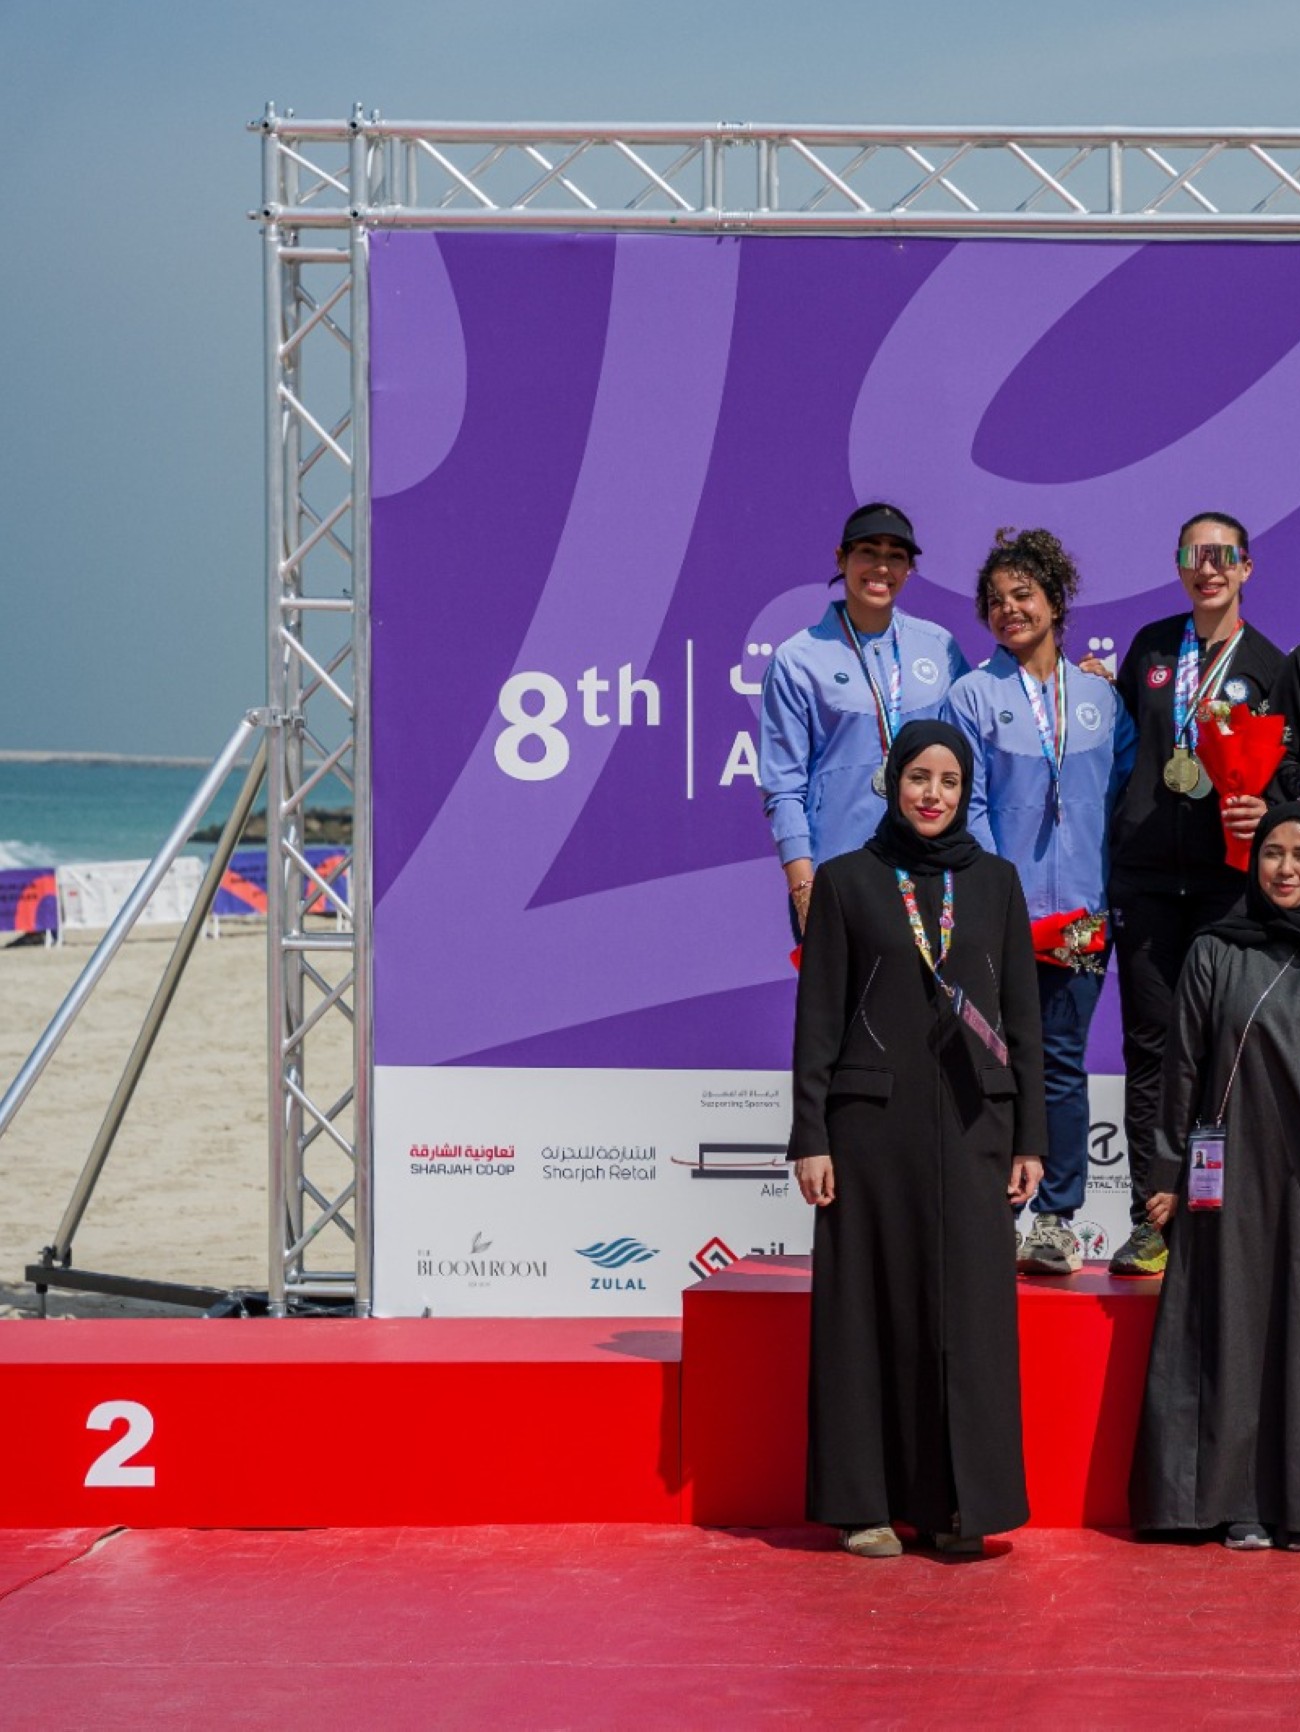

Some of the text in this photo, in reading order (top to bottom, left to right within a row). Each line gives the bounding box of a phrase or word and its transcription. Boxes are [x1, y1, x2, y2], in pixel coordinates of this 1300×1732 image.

[494, 662, 661, 781] 8th
[409, 1143, 515, 1162] تعاونية الشارقة
[410, 1163, 515, 1176] SHARJAH CO-OP
[542, 1164, 657, 1182] Sharjah Retail
[760, 1183, 790, 1198] Alef
[590, 1278, 647, 1290] ZULAL
[84, 1399, 156, 1488] 2
